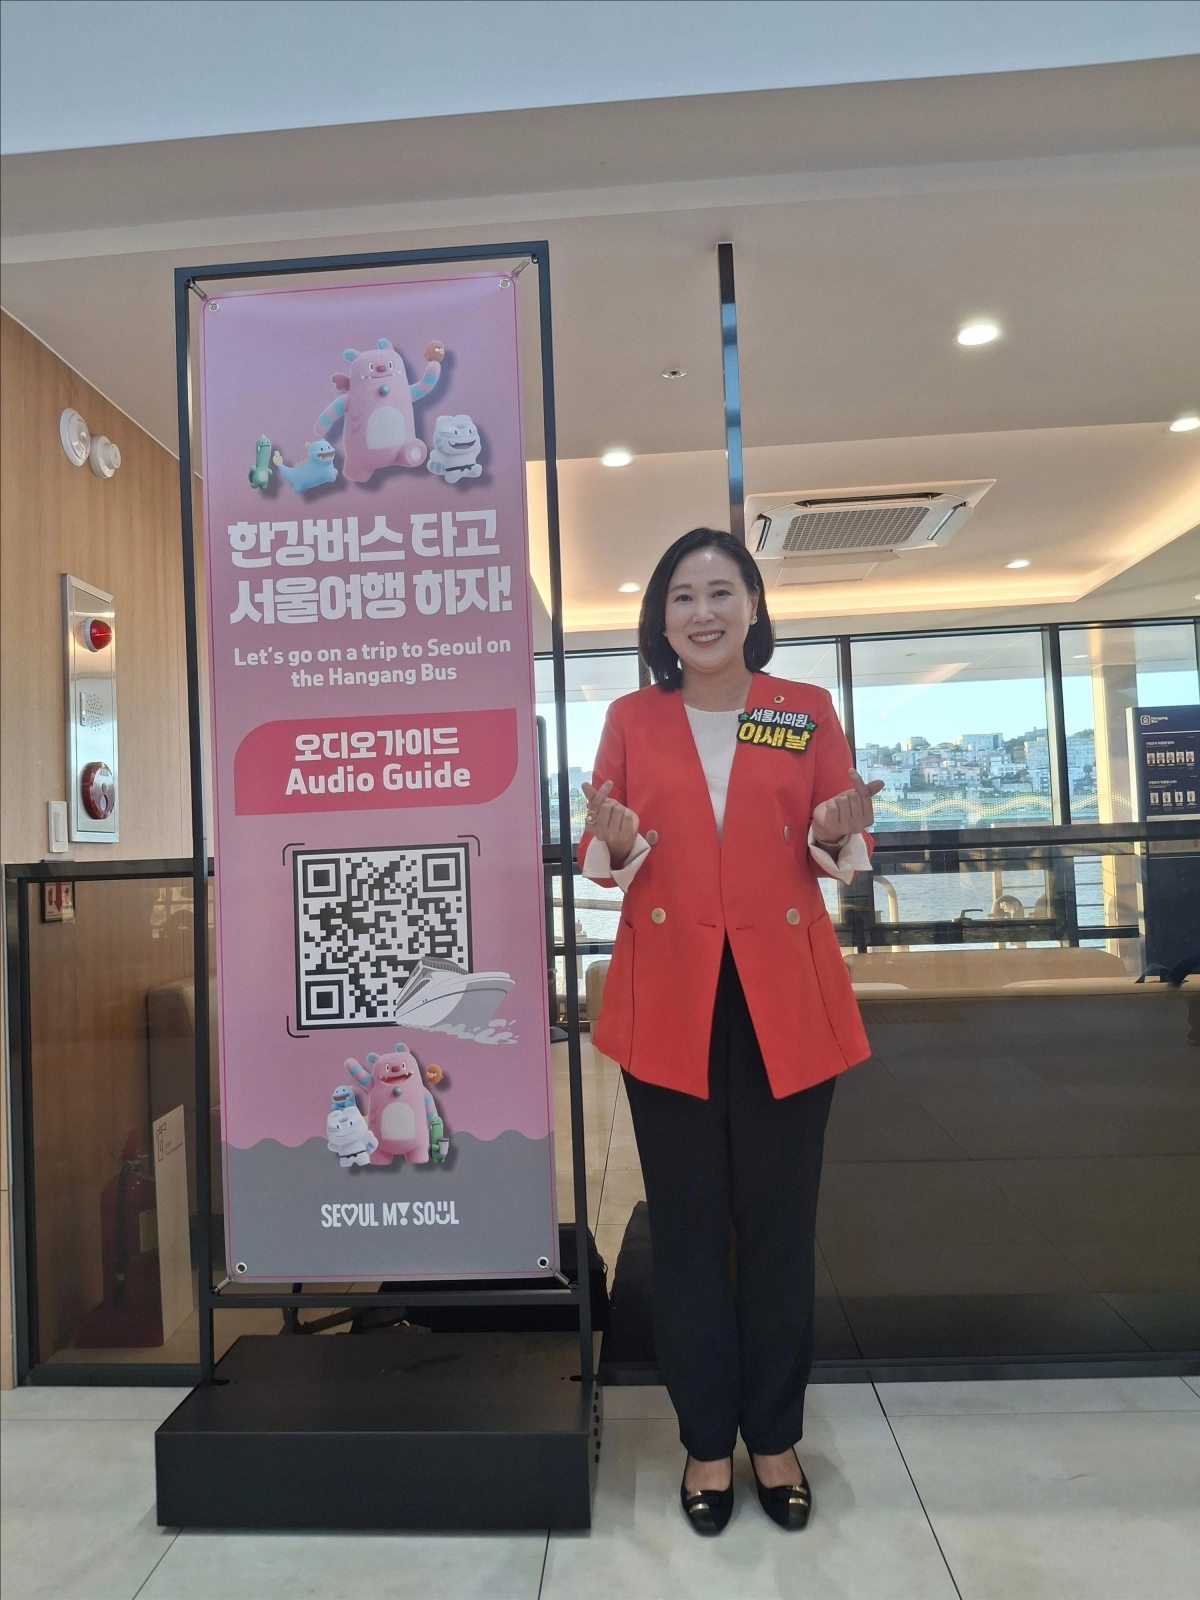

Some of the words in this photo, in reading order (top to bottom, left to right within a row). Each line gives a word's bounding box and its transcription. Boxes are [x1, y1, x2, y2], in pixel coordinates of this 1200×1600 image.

[228, 516, 406, 568] 한강버스
[410, 509, 500, 557] 타고
[230, 571, 406, 624] 서울여행
[412, 565, 513, 615] 하재!
[288, 650, 313, 667] go
[317, 648, 342, 662] on
[346, 647, 358, 661] a
[361, 641, 398, 662] trip
[402, 642, 423, 658] to
[427, 636, 482, 657] Seoul
[487, 639, 511, 653] on
[291, 670, 324, 688] the
[328, 667, 416, 686] Hangang
[421, 663, 458, 682] Bus
[750, 708, 808, 728] 서울시의원
[294, 727, 460, 762] 오디오가이드
[738, 722, 810, 750] 이새날
[285, 765, 375, 796] Audio
[382, 760, 471, 791] Guide
